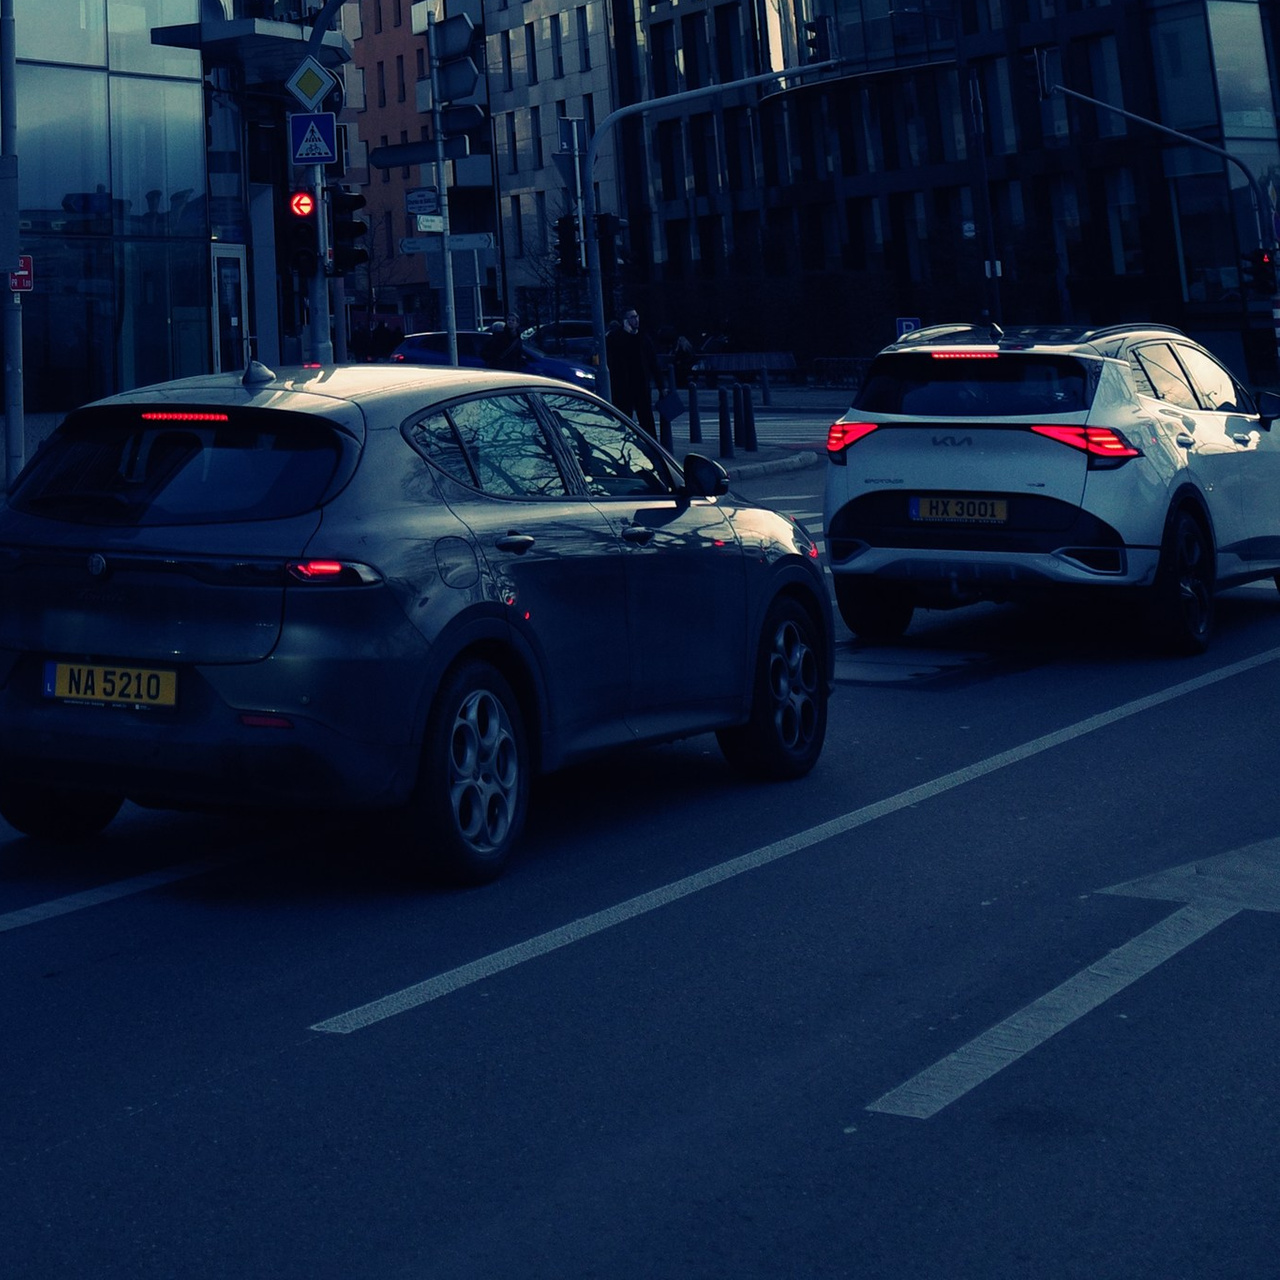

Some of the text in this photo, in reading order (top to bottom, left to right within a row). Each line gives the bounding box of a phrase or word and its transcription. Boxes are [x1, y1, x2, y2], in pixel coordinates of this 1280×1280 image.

[902, 321, 915, 334] P
[932, 436, 973, 447] KIA
[929, 500, 996, 518] HX 3001
[47, 682, 52, 692] L
[69, 668, 161, 701] NA 5210
